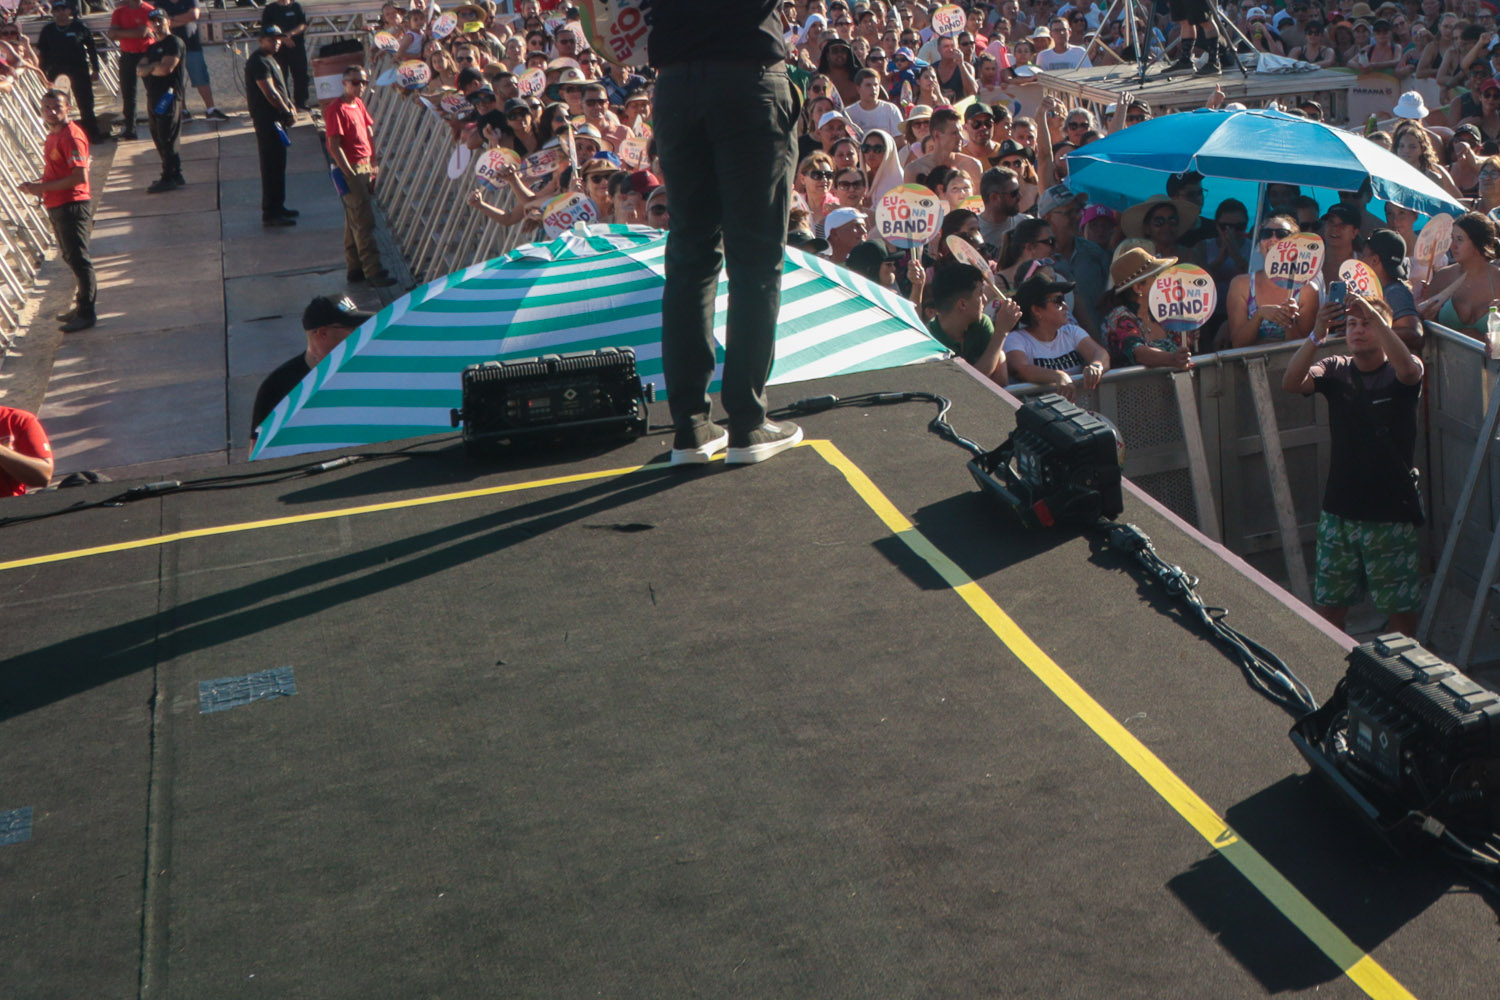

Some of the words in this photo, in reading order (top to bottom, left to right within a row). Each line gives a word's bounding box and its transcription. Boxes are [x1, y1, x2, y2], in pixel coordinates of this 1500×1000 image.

[610, 7, 648, 49] TÔ
[609, 37, 632, 63] EU
[489, 150, 501, 158] EU
[882, 196, 898, 207] EU
[887, 199, 911, 221] TÔ
[912, 209, 926, 217] NA
[544, 214, 557, 226] EU
[553, 211, 572, 230] TÔ
[570, 206, 582, 216] NA
[882, 213, 934, 234] BAND!
[1277, 241, 1291, 250] EU
[1279, 243, 1299, 262] TÔ
[1270, 256, 1318, 275] BAND!
[1355, 262, 1368, 276] EU
[1156, 277, 1172, 289] EU
[1352, 272, 1370, 291] TÔ
[1161, 280, 1186, 303] TÔ
[1186, 289, 1201, 297] NA
[1158, 293, 1209, 317] BAND!
